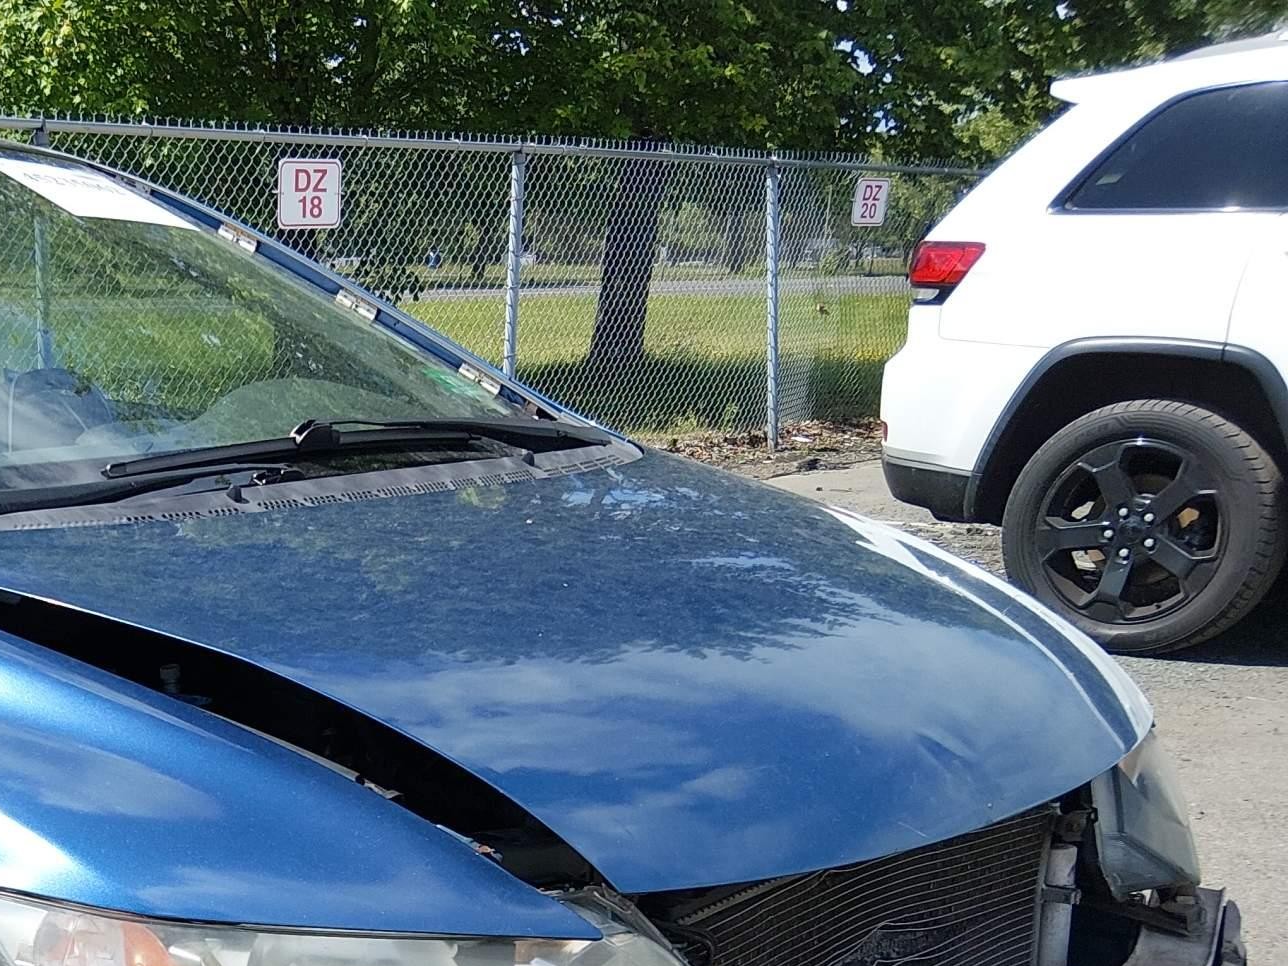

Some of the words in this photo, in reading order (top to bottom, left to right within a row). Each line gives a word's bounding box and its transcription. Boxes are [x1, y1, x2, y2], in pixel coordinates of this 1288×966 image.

[294, 168, 328, 193] DZ
[863, 185, 883, 201] DZ
[297, 195, 323, 219] 18
[861, 203, 877, 219] 20
